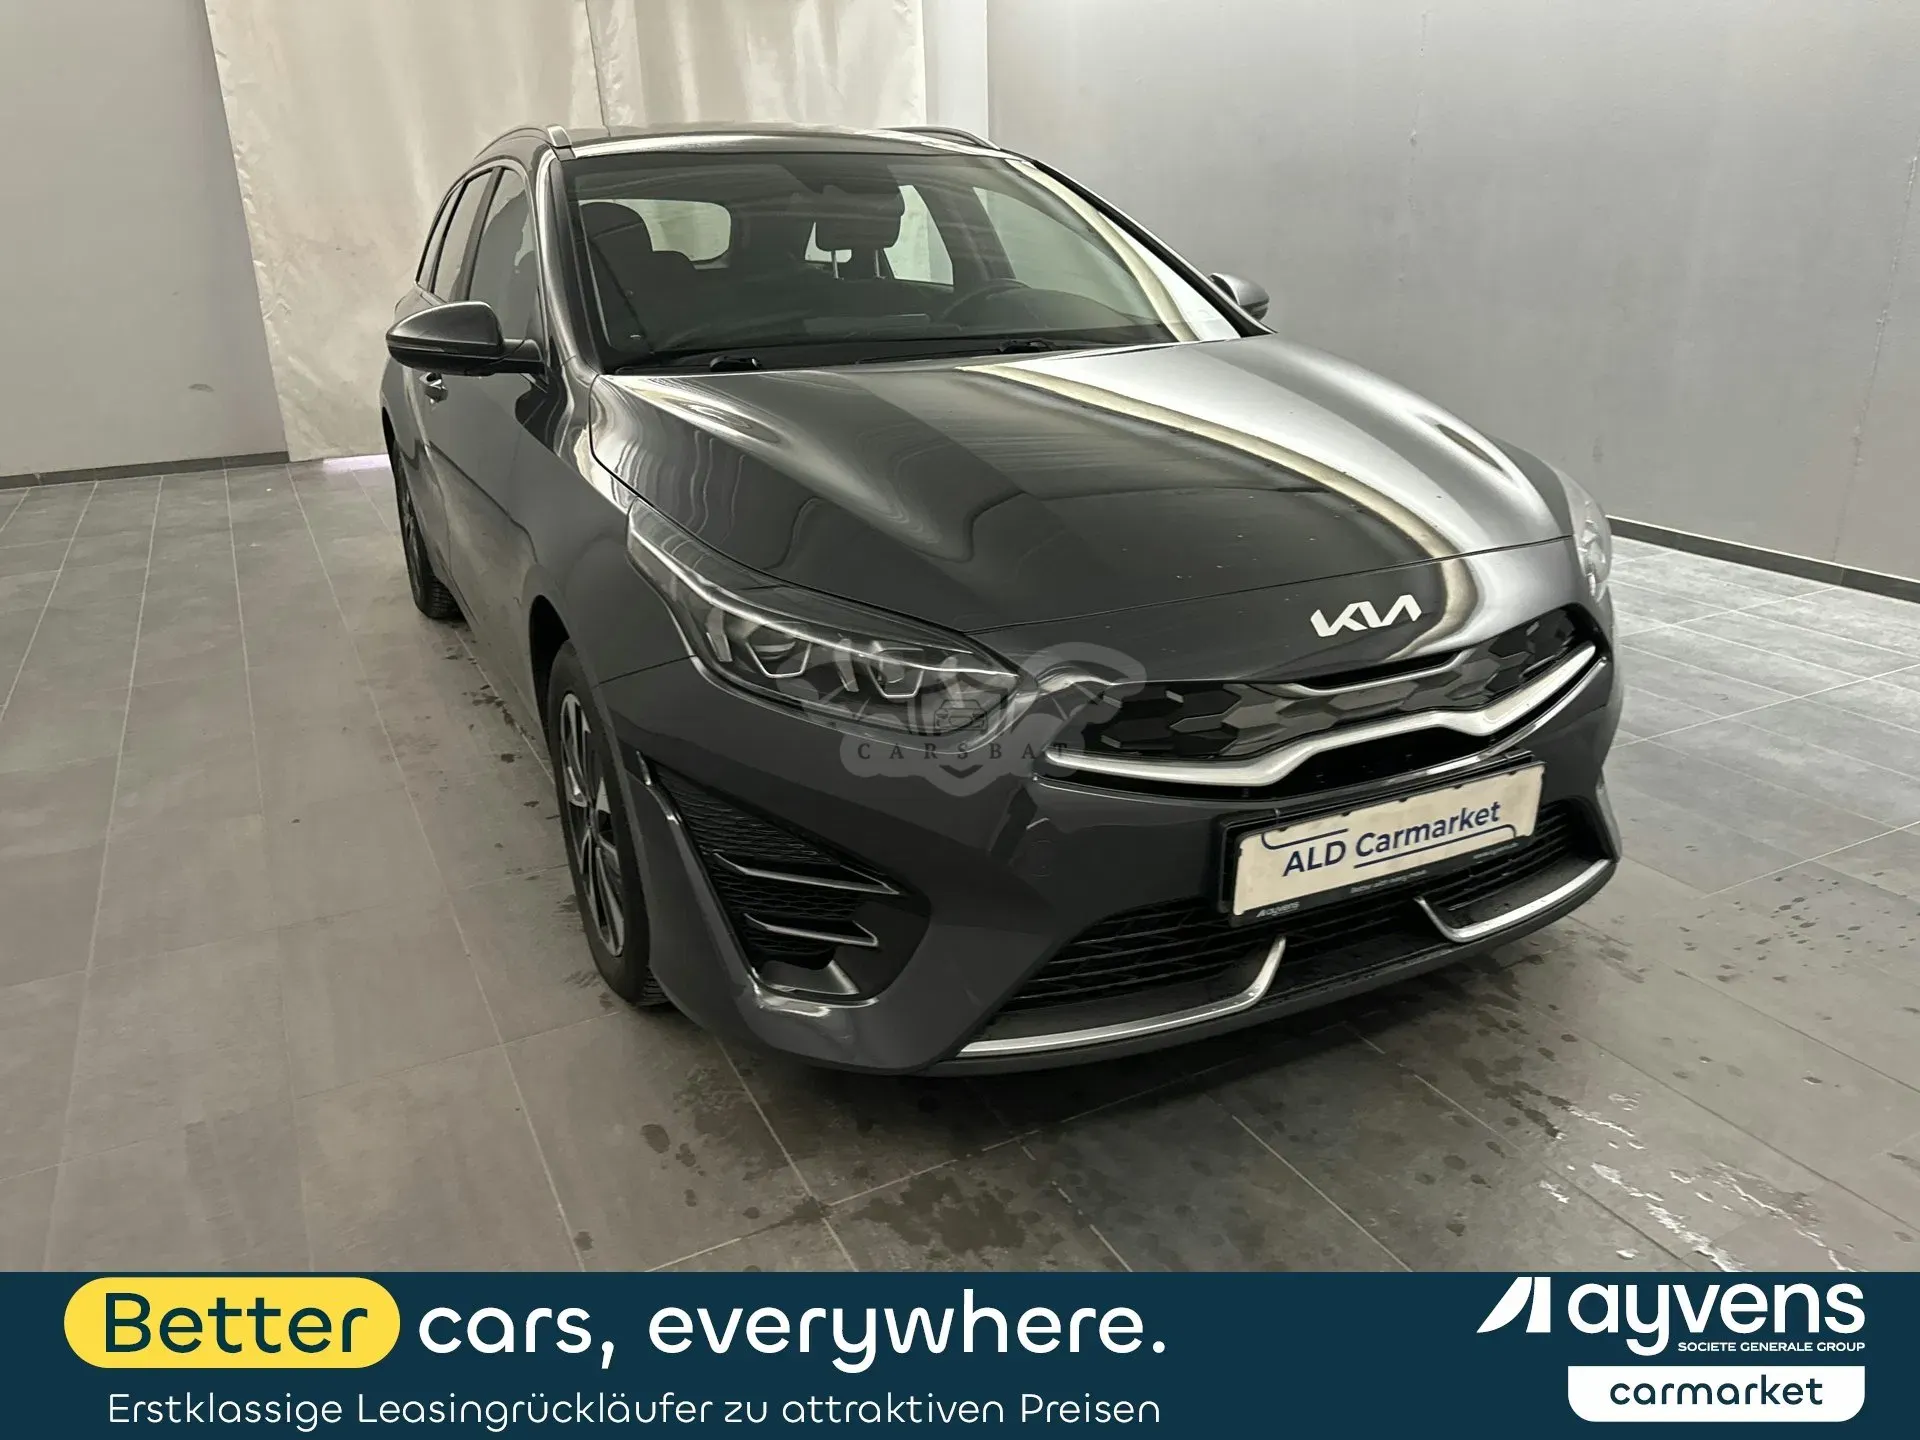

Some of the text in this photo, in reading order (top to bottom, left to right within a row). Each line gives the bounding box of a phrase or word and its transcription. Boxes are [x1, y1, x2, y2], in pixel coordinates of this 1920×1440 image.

[1310, 594, 1422, 637] KIA
[1283, 801, 1501, 877] ALD Carmarket
